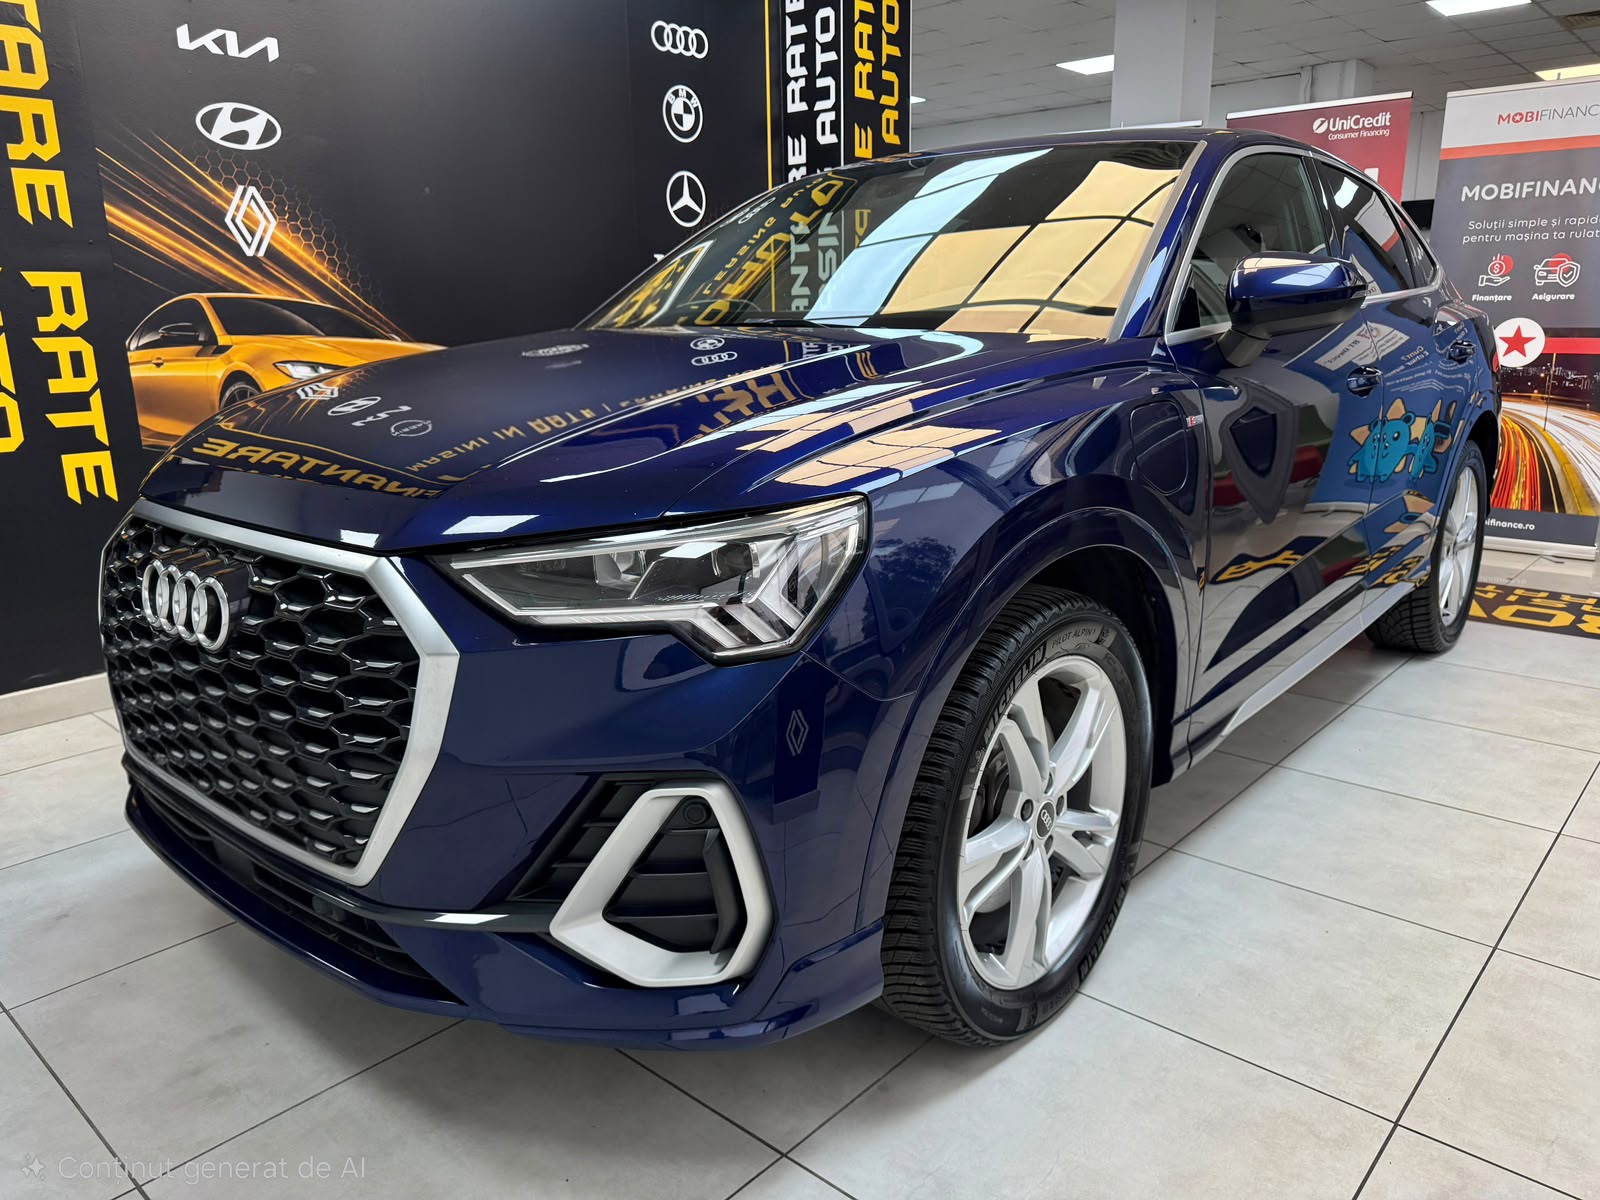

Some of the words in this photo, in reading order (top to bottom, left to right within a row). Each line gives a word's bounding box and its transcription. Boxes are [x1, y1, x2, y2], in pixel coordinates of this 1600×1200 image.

[814, 6, 839, 145] AUTO
[880, 0, 902, 145] AUTO
[1329, 111, 1391, 131] UniCredit
[1328, 132, 1359, 140] Consumer
[1360, 128, 1390, 138] Financing
[1461, 177, 1600, 202] MOBIFINAN
[1507, 217, 1548, 229] simple
[1564, 214, 1600, 227] rapid
[1462, 233, 1502, 245] pentru
[1553, 230, 1566, 240] ta
[1531, 292, 1576, 302] Asigurare
[20, 271, 119, 505] RATE
